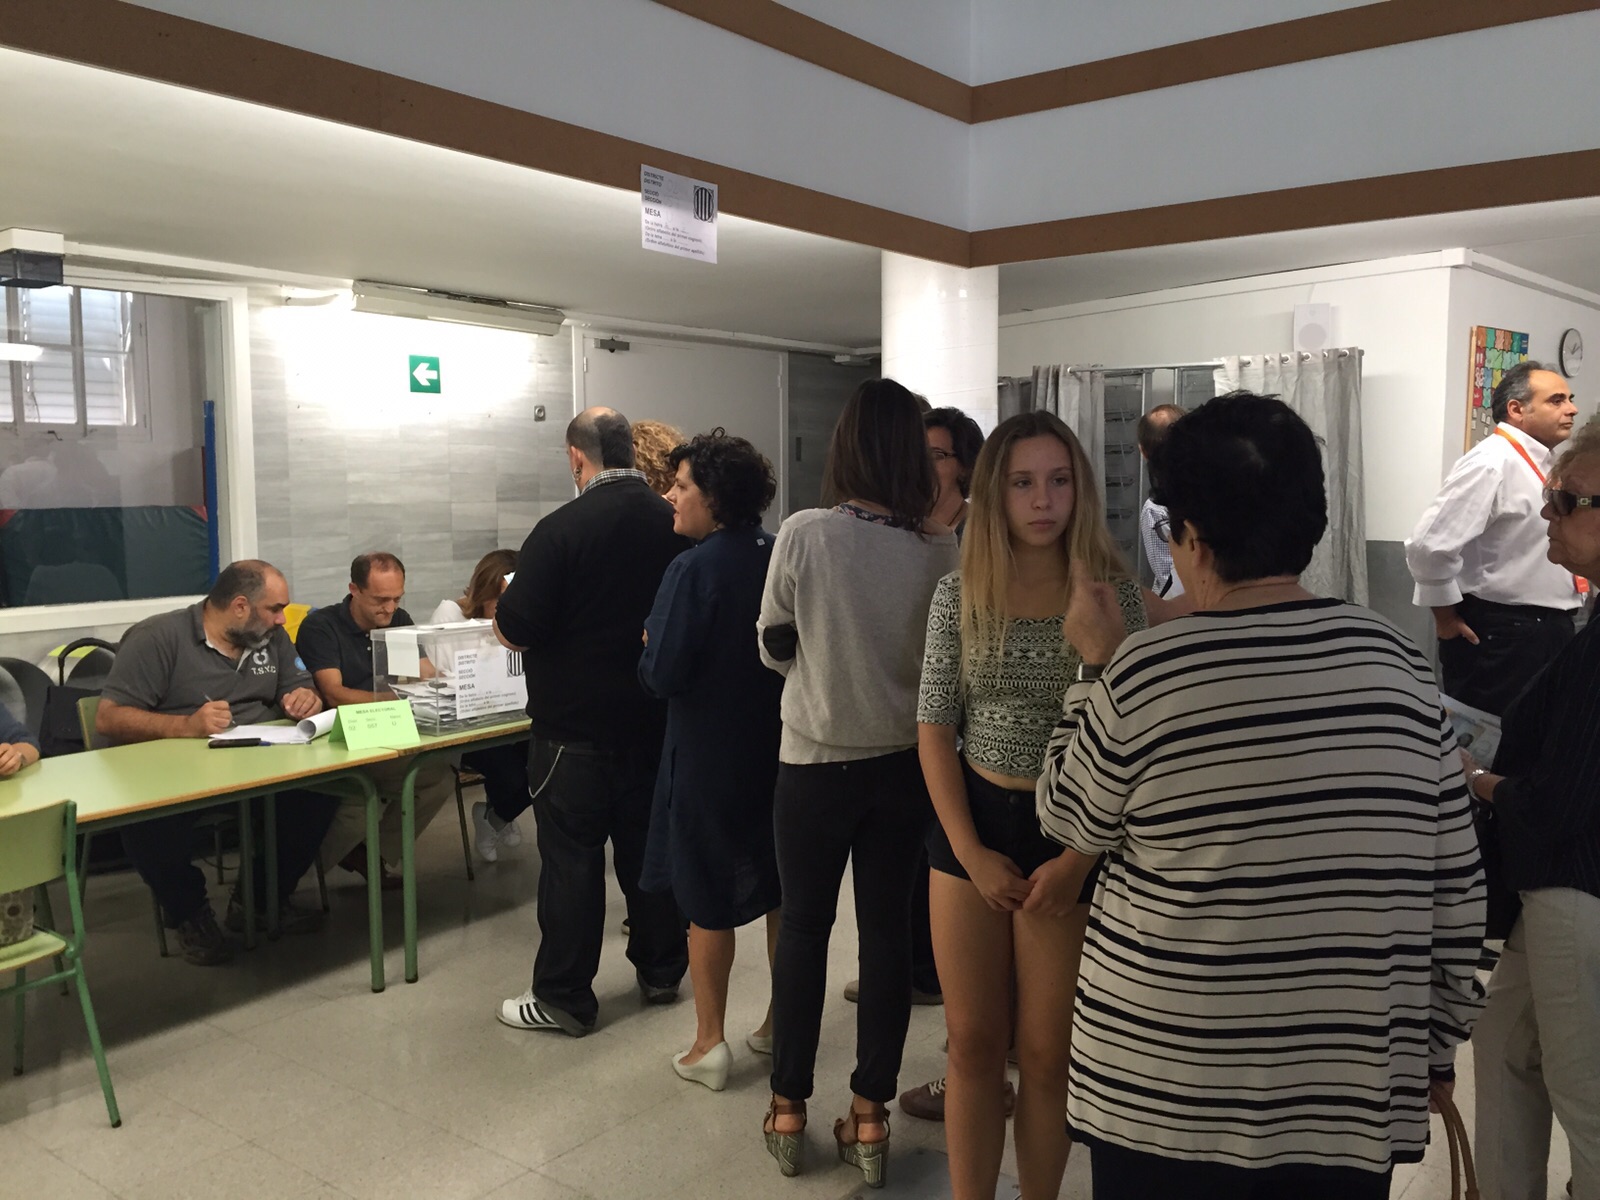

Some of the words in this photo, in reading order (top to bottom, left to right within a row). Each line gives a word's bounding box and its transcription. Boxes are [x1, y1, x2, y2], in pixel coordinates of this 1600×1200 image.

[644, 171, 664, 181] DISTRICTE
[644, 178, 662, 187] DISTRITO
[645, 208, 661, 218] MESA
